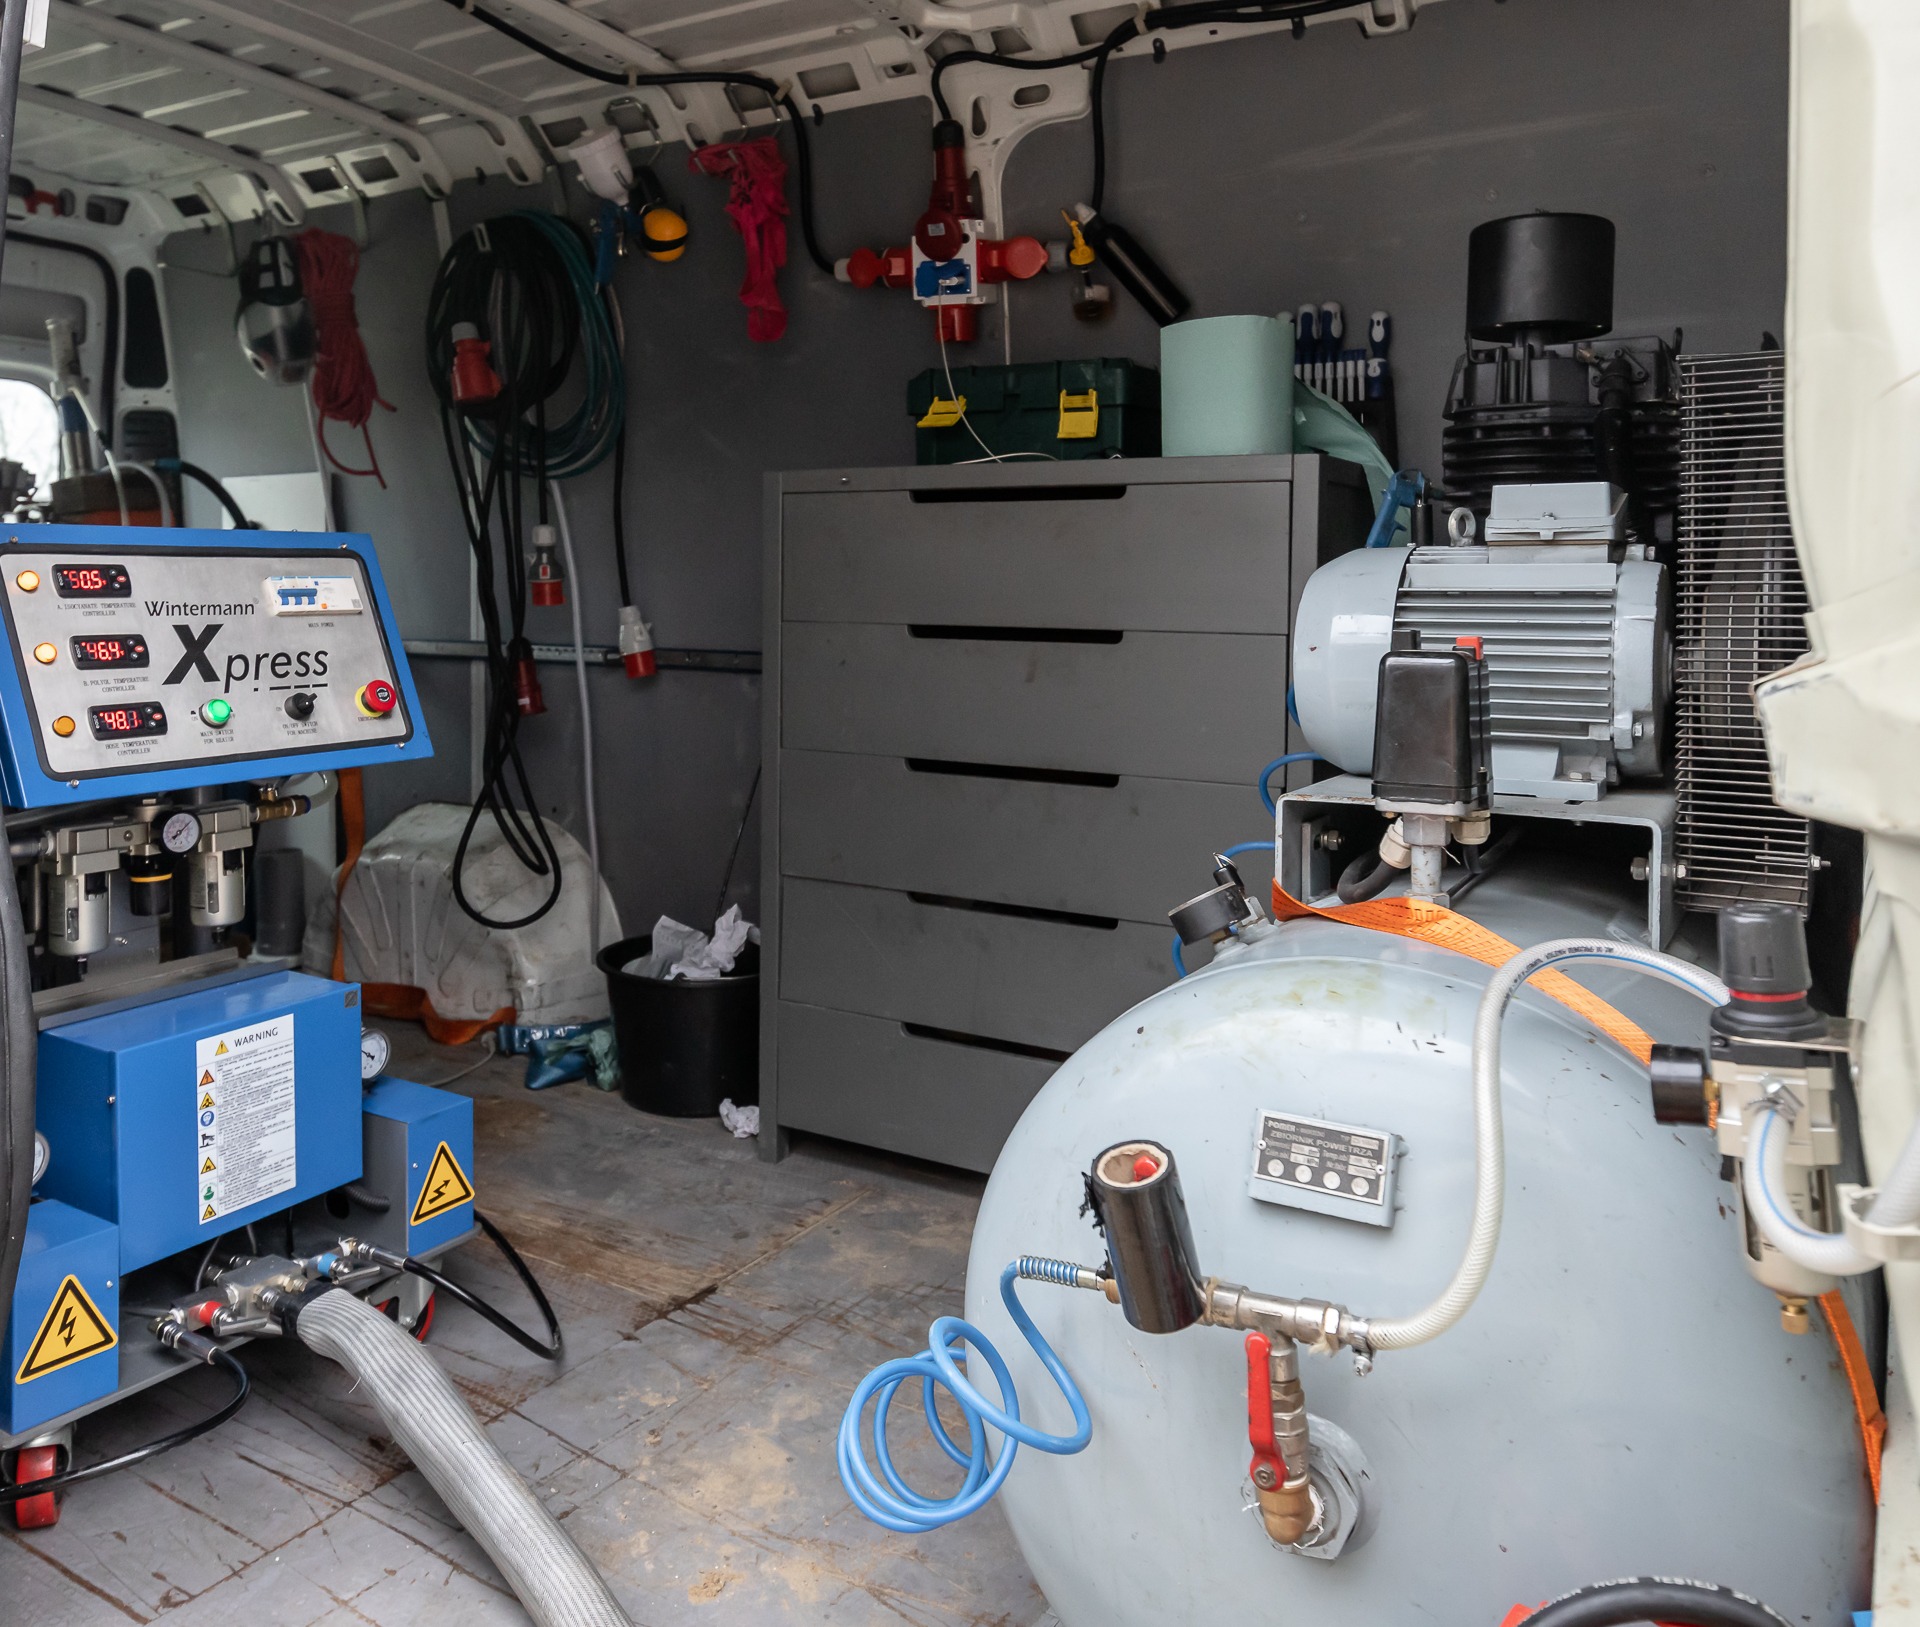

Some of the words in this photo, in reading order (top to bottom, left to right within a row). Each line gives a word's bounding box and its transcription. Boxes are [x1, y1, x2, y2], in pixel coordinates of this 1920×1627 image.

[144, 600, 255, 616] Wintermann
[86, 641, 120, 660] 46.4
[161, 623, 328, 694] Xpress
[113, 676, 149, 684] TEMPERATURE
[102, 685, 136, 693] CONTROLLER
[104, 710, 138, 730] 48.1
[117, 748, 151, 756] CONTROLLER
[122, 740, 159, 748] TEMPERATURE
[234, 1026, 278, 1047] WARNING
[1270, 1130, 1315, 1145] ZBIORNIK
[1316, 1139, 1373, 1157] POWIETRZA
